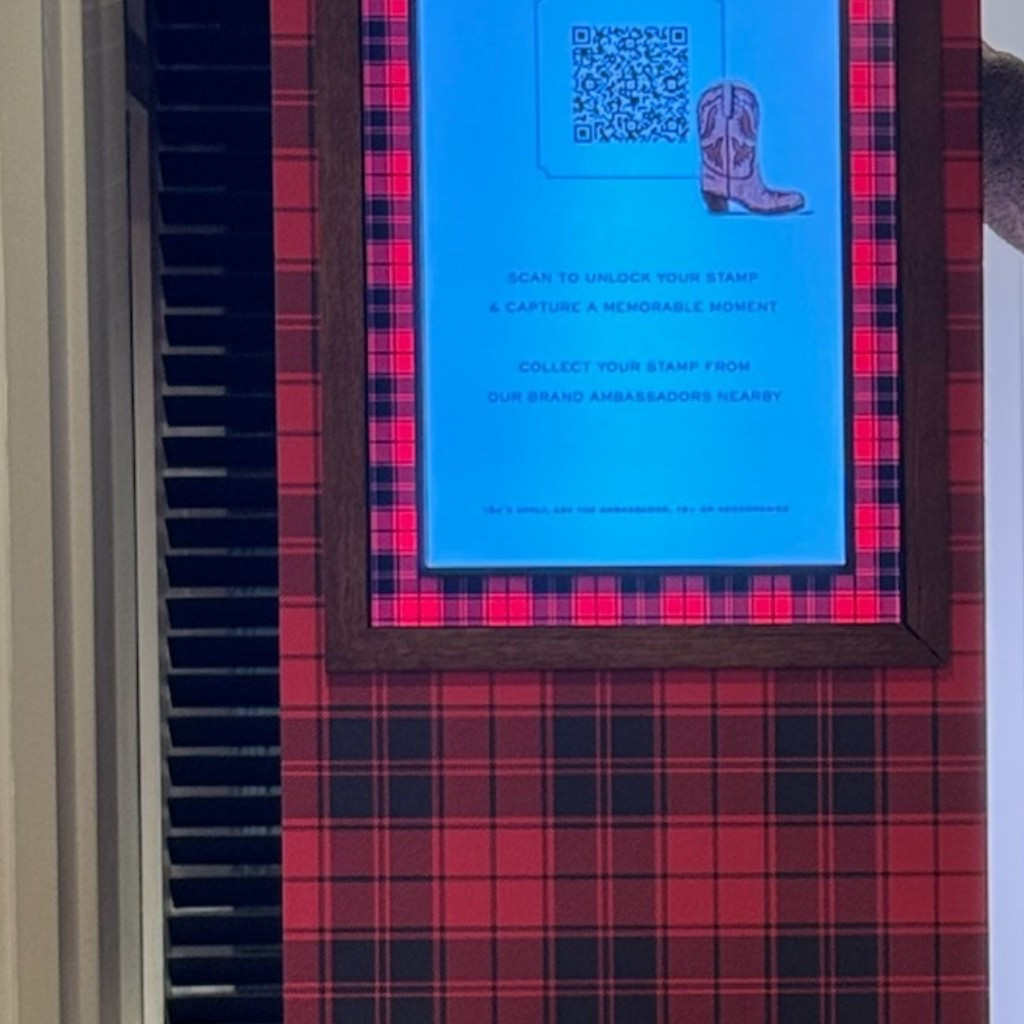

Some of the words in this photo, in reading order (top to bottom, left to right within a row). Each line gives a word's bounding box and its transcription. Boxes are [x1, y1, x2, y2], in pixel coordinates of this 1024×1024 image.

[507, 271, 553, 285] SCAN
[557, 271, 581, 285] TO
[583, 271, 652, 285] UNLOCK
[655, 271, 701, 284] YOUR
[705, 271, 759, 284] STAMP
[488, 301, 501, 314] &
[504, 300, 582, 314] CAPTURE
[586, 300, 599, 313] A
[602, 300, 705, 314] MEMORABLE
[708, 300, 778, 314] MOMENT
[517, 359, 591, 374] COLLECT
[595, 359, 642, 374] YOUR
[645, 359, 700, 374] STAMP
[703, 359, 751, 374] FROM
[487, 390, 523, 404] OUR
[526, 389, 585, 404] BRAND
[588, 389, 713, 404] AMBASSADORS
[716, 389, 782, 403] NEARBY
